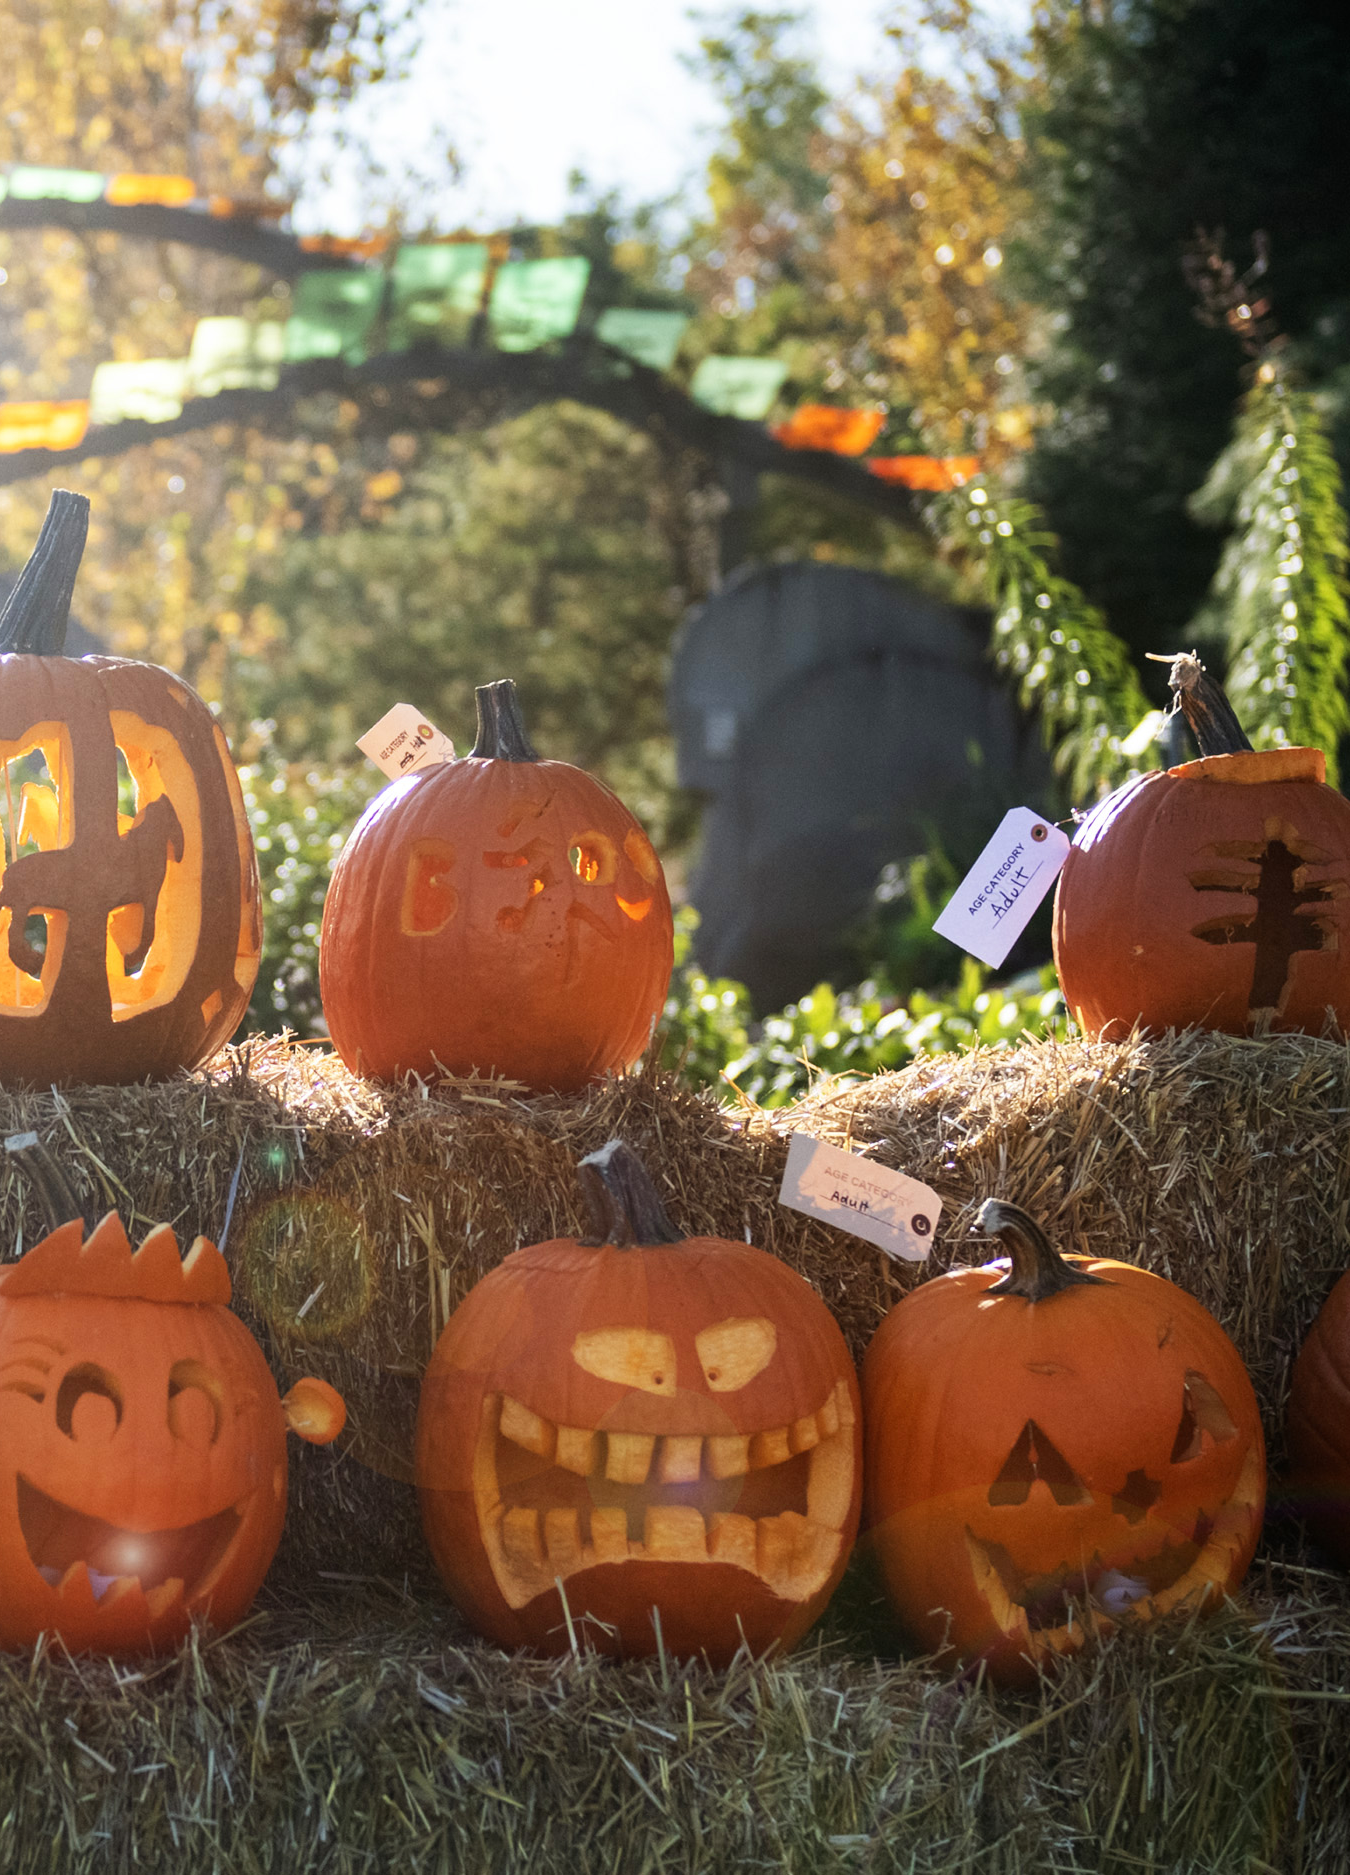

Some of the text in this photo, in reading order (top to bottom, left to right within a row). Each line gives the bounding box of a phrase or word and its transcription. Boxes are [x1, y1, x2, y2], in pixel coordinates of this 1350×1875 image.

[385, 730, 409, 755] CATEGORY
[968, 842, 1025, 916] AGE CATEGORY
[991, 866, 1029, 919] Adult
[824, 1166, 914, 1208] AGE CATEGORY
[830, 1190, 869, 1212] Adult
